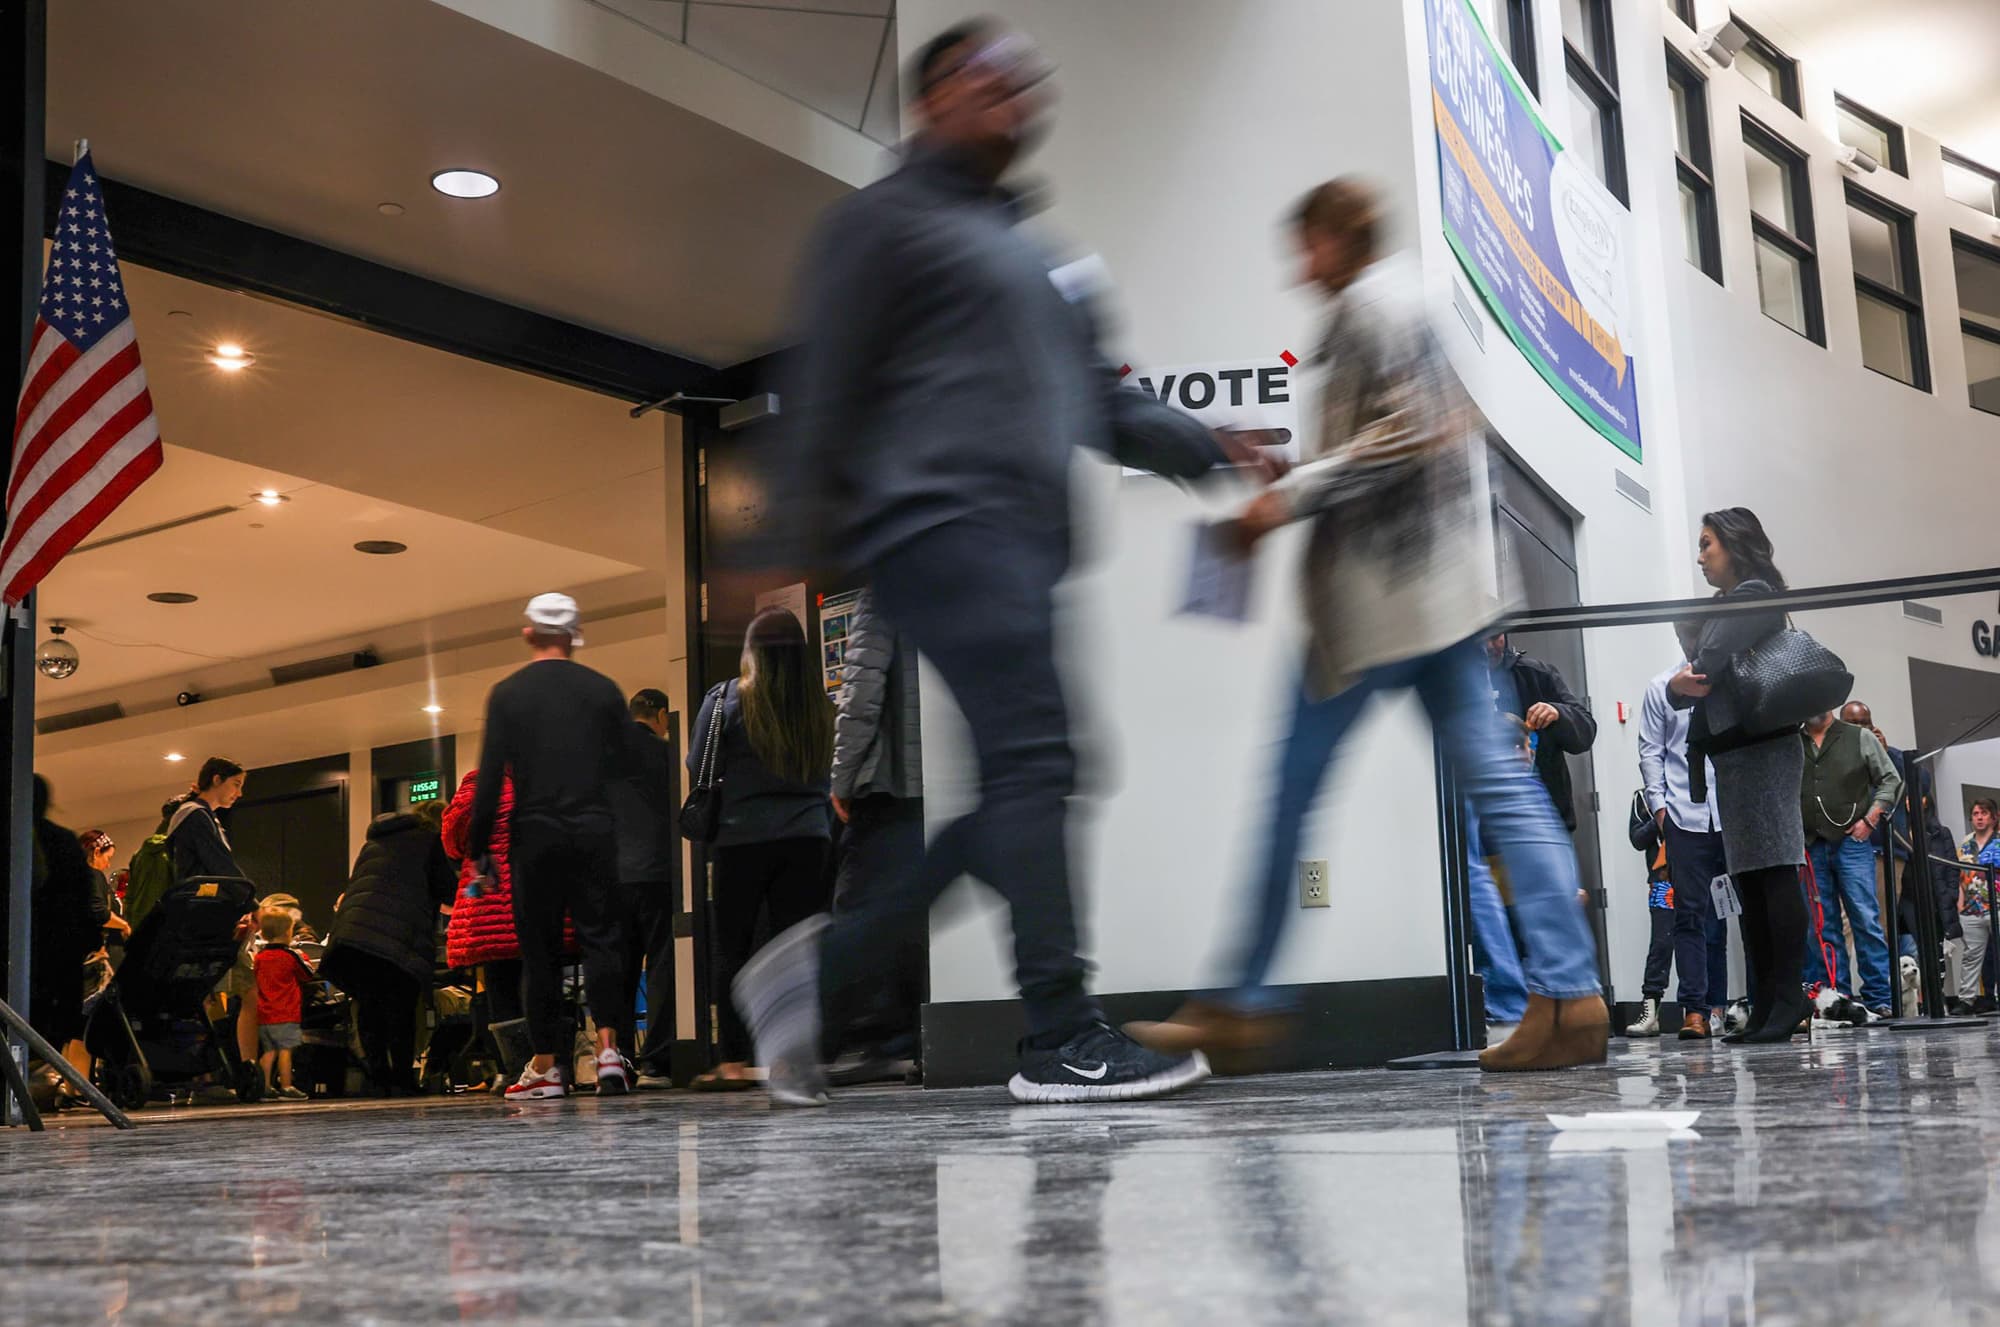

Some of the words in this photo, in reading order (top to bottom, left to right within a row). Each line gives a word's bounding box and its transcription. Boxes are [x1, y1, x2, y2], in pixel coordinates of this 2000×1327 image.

[1436, 21, 1534, 232] BUSINESSES
[1475, 46, 1507, 137] FOR
[1138, 366, 1290, 409] VOTE
